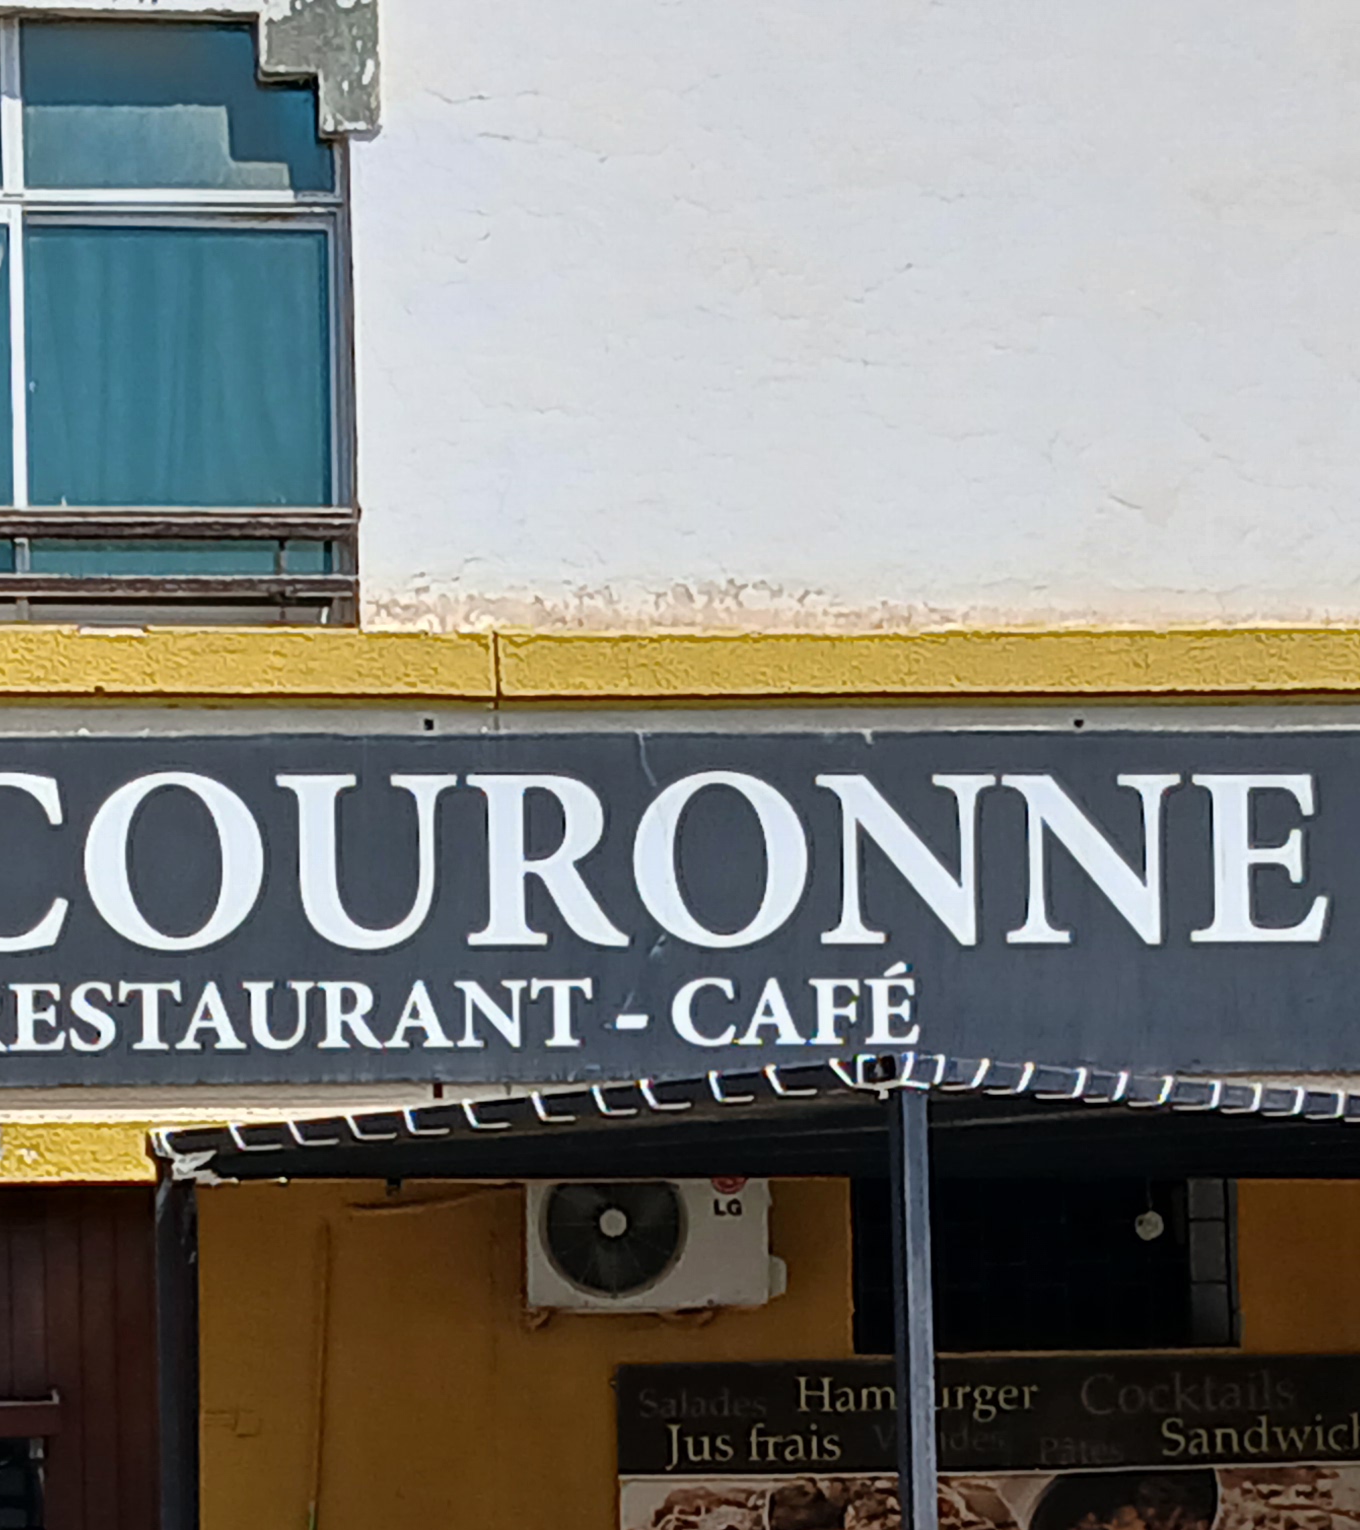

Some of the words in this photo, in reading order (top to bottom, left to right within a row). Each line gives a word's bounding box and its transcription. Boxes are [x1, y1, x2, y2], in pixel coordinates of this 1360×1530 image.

[671, 961, 921, 1047] CAFÉ
[713, 1198, 743, 1217] LG
[640, 1387, 768, 1419] Salades
[795, 1376, 1039, 1422] Hamurger
[1080, 1369, 1297, 1415] Cocktails
[665, 1423, 734, 1470] Jus
[749, 1422, 842, 1462] frais
